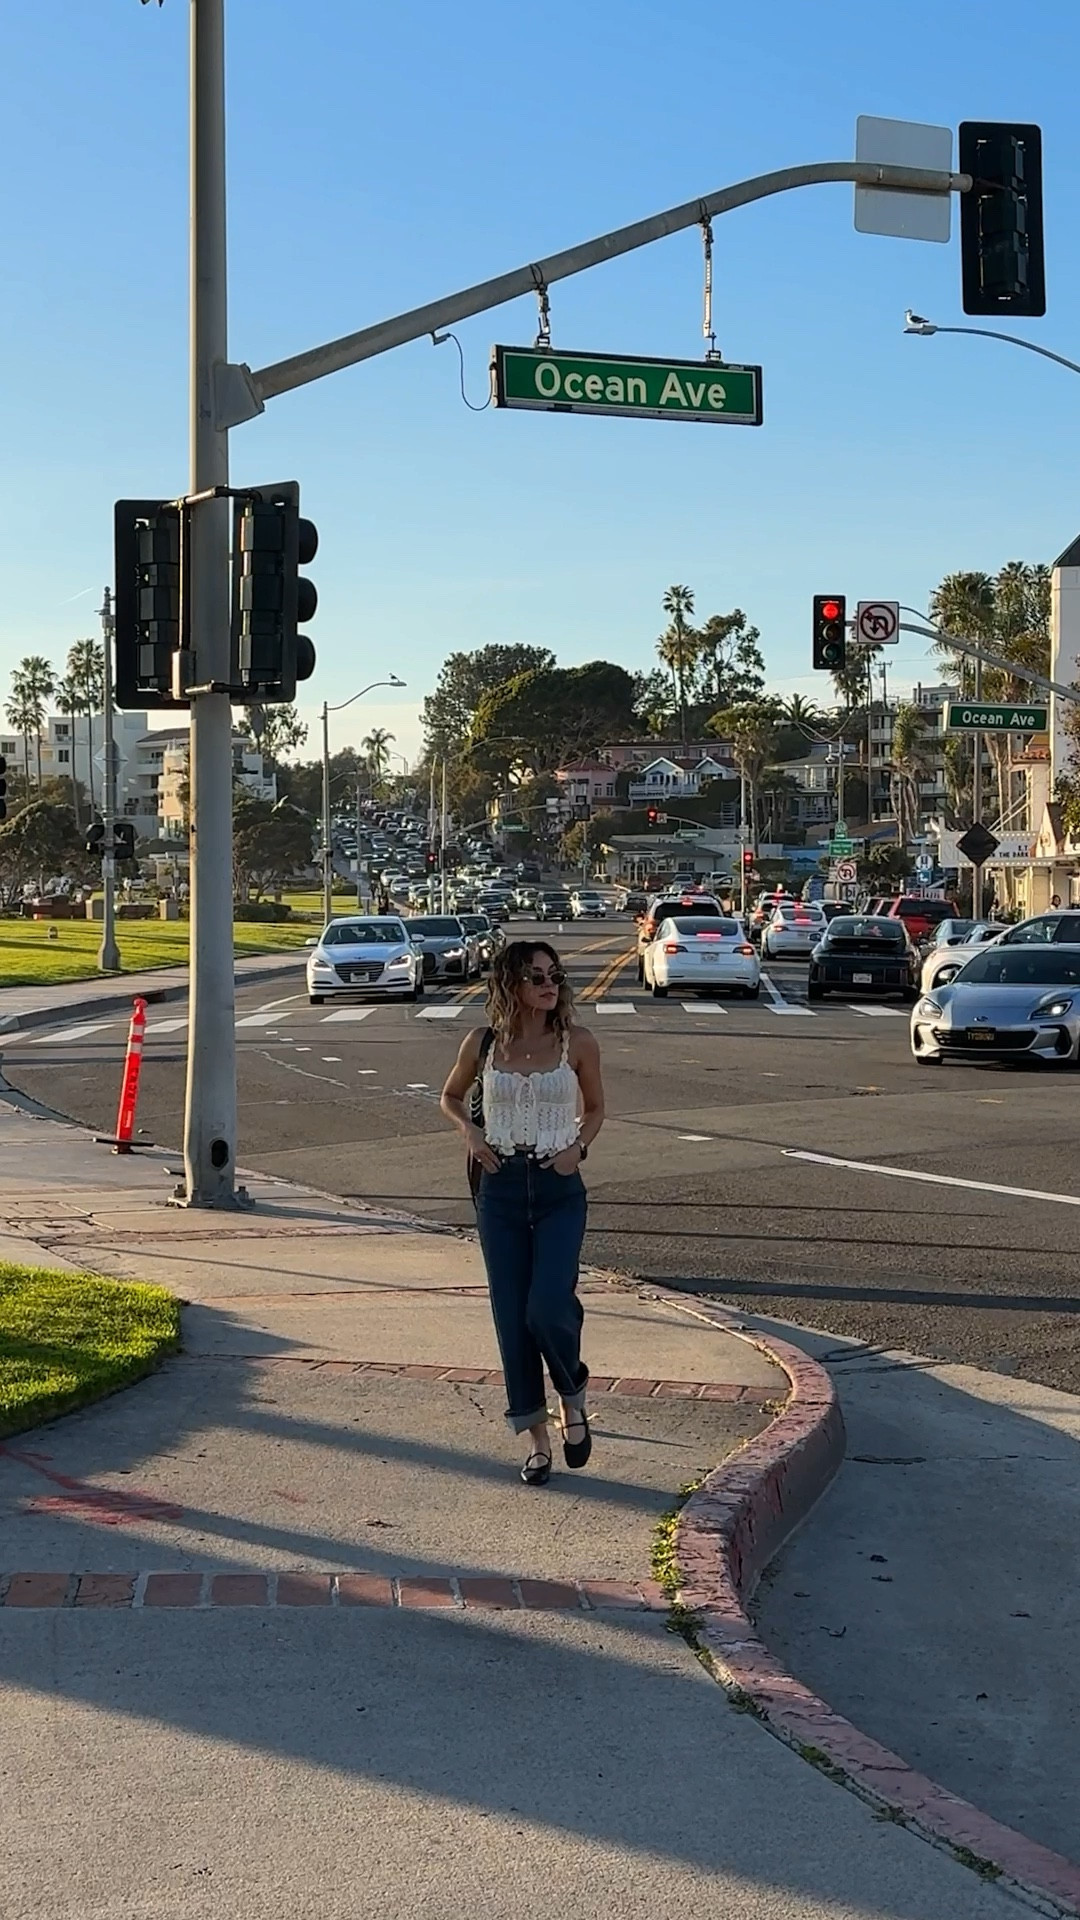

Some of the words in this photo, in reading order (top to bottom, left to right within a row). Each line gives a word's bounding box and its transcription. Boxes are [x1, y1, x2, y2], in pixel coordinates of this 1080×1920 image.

[535, 362, 647, 405] Ocean
[659, 372, 727, 409] Ave
[962, 710, 1003, 725] Ocean
[1010, 712, 1035, 726] Ave
